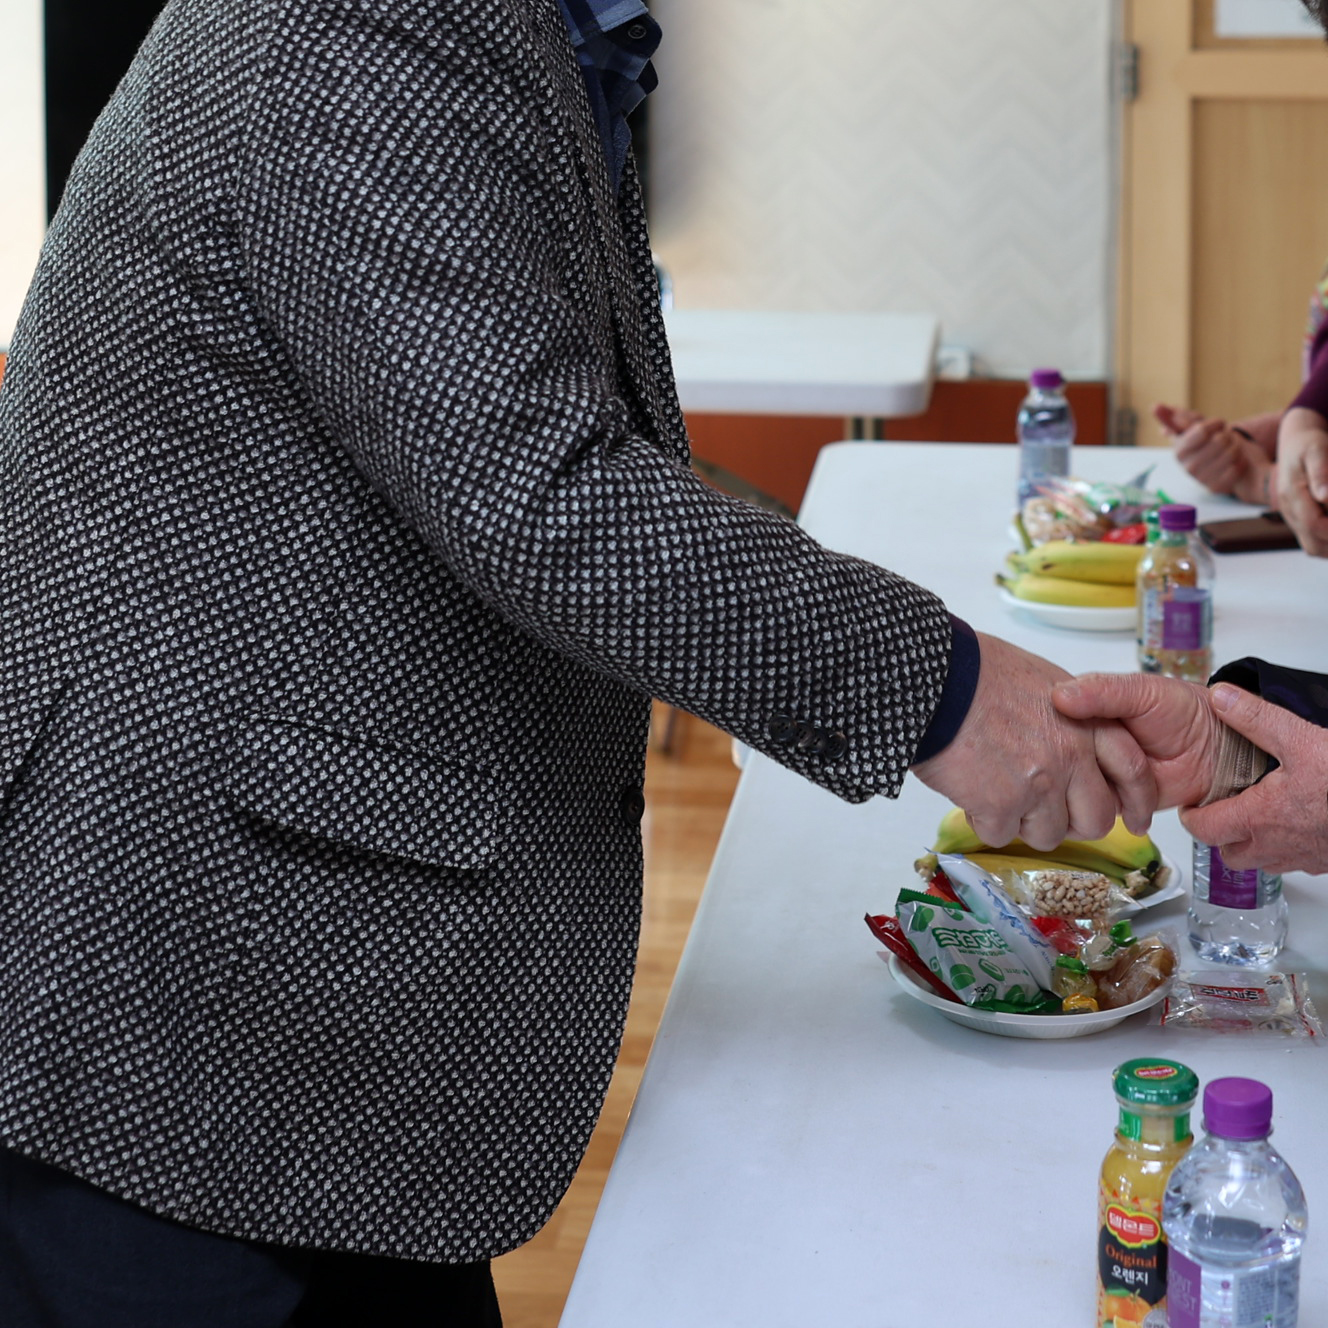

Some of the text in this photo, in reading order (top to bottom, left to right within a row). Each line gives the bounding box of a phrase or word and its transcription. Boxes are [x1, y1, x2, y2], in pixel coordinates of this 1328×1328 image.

[1108, 1210, 1155, 1238] 델몬트
[1105, 1243, 1158, 1269] Original
[1111, 1264, 1149, 1287] 오렌지
